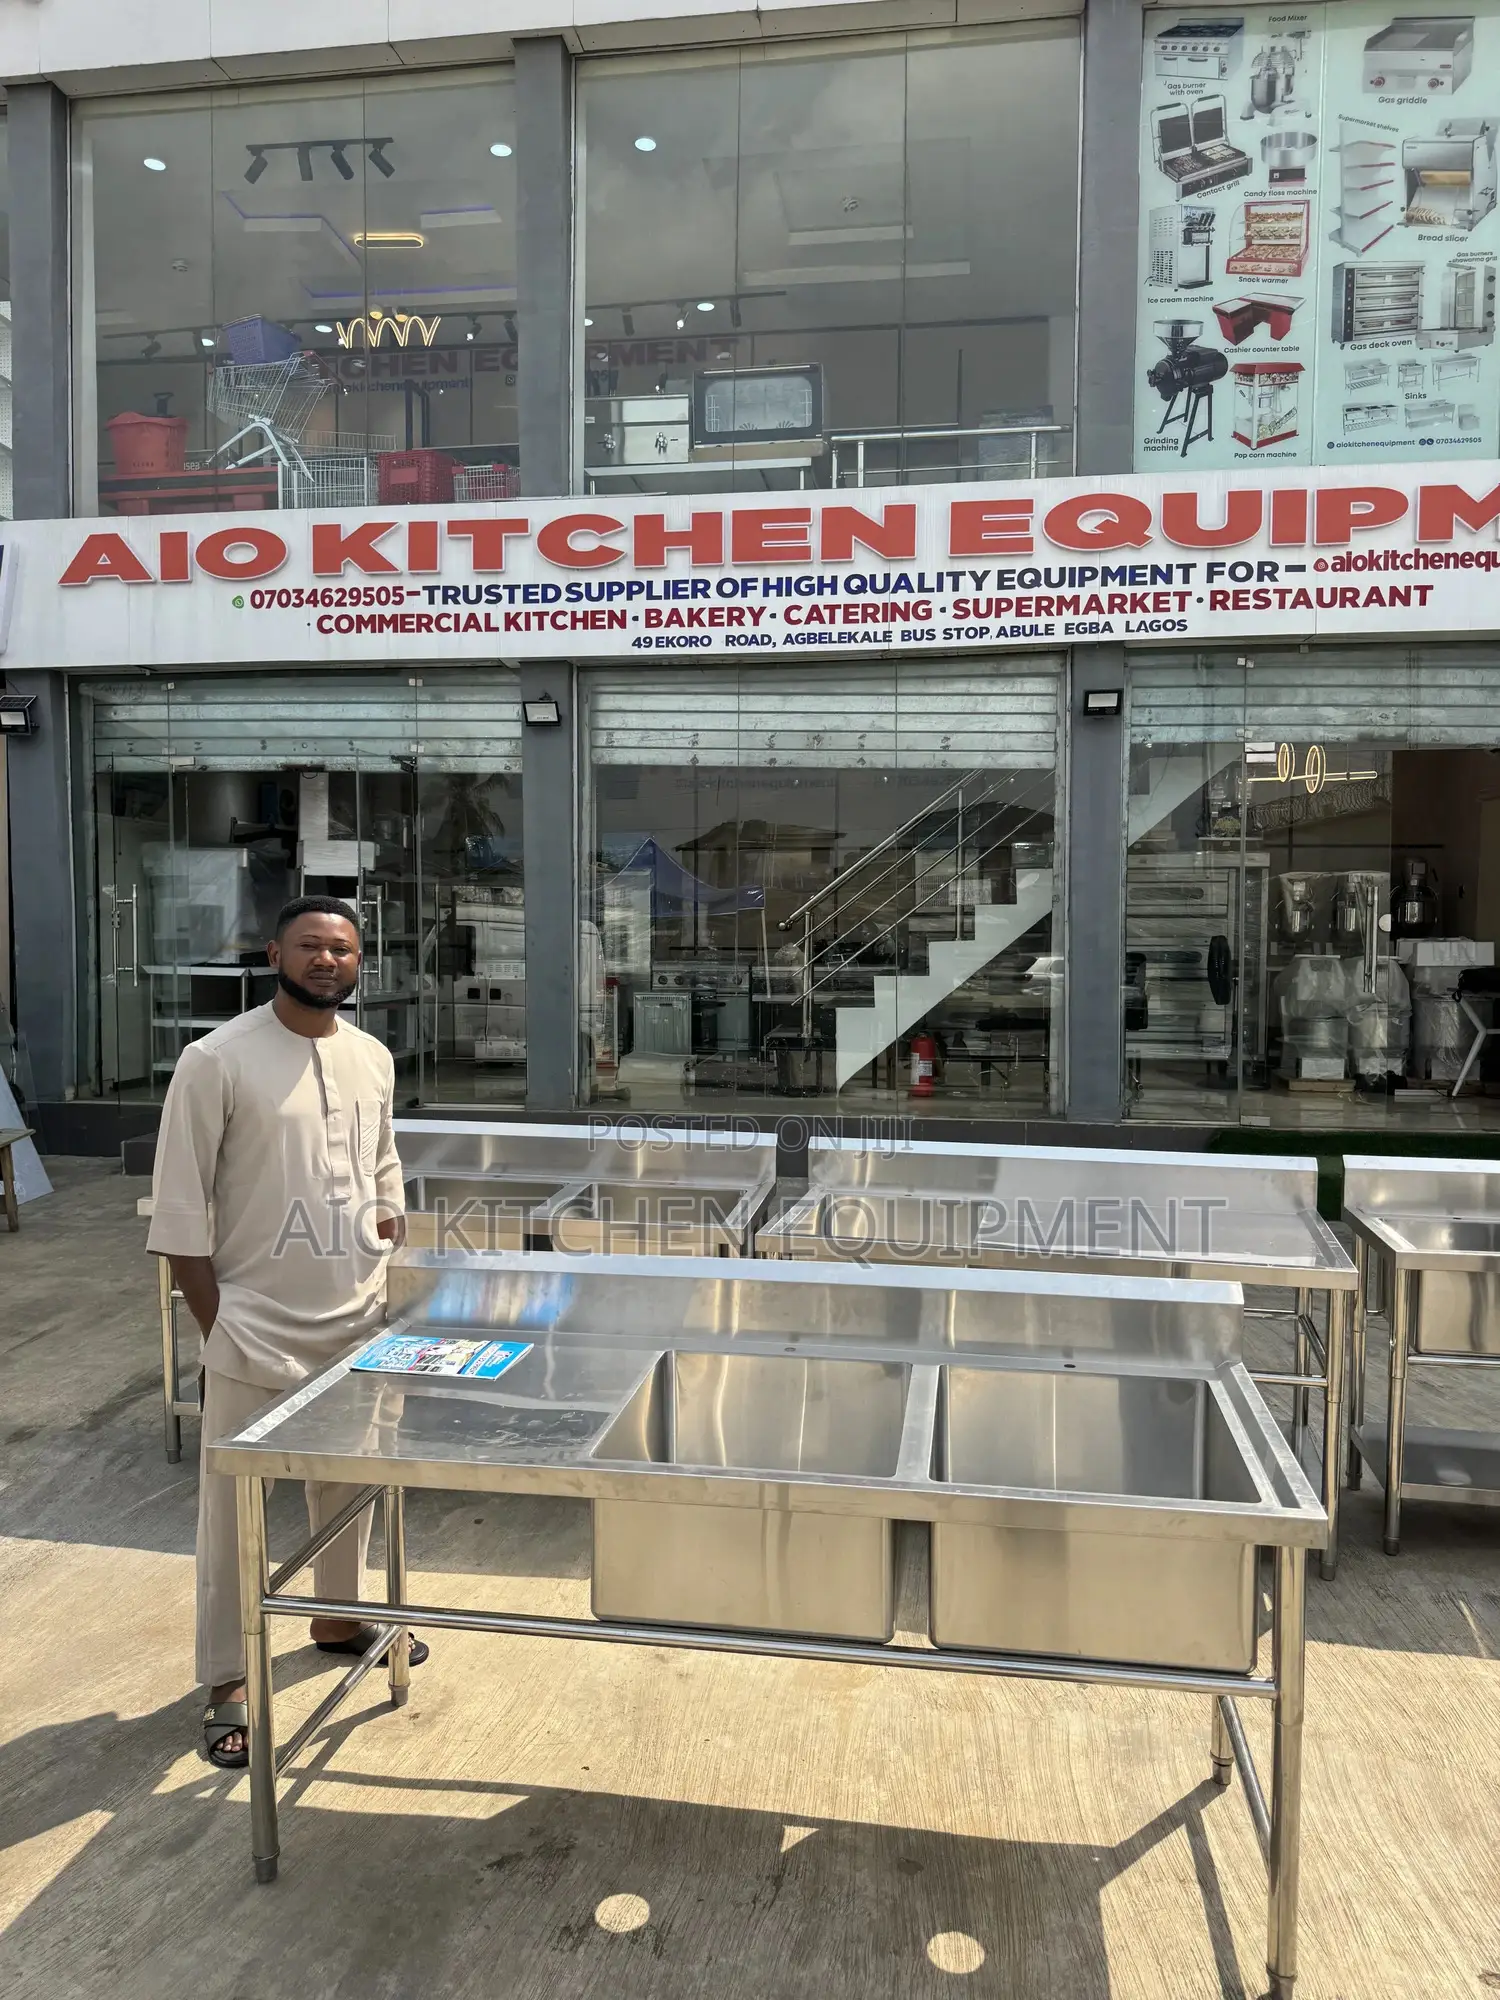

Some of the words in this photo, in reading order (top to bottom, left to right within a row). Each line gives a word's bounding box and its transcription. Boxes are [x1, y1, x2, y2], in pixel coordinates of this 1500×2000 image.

[1268, 14, 1285, 23] Food
[1286, 13, 1308, 22] Mixer
[1378, 96, 1395, 104] Gas
[1396, 96, 1428, 107] griddle
[1196, 183, 1223, 199] Contact
[1223, 179, 1241, 192] grill
[1243, 190, 1266, 200] Candy
[1266, 189, 1284, 197] floss
[1285, 188, 1318, 197] machine
[1417, 234, 1443, 242] Bread
[1444, 234, 1469, 242] slicer
[1238, 276, 1260, 284] Snack
[1261, 277, 1289, 285] warmer
[1183, 296, 1214, 304] machine
[1223, 346, 1250, 355] Cashier
[1252, 345, 1280, 354] counter
[1281, 344, 1300, 353] table
[1350, 342, 1367, 351] Gas
[1369, 340, 1390, 349] deck
[1391, 340, 1412, 348] oven
[1404, 392, 1428, 400] Sinks
[1143, 437, 1179, 446] Grinding
[1143, 444, 1179, 452] machine
[1234, 452, 1247, 460] Pop
[1266, 450, 1297, 459] machine
[58, 526, 288, 586] AIO
[311, 504, 918, 577] KITCHEN
[949, 482, 1500, 556] EQUIPM
[422, 582, 562, 606] TRUSTED
[564, 579, 712, 602] SUPPLIER
[715, 577, 759, 598] OF
[762, 575, 838, 597] HIGH
[842, 569, 991, 595] QUALITY
[996, 562, 1197, 591] EQUIPMENT
[315, 610, 500, 634] COMMERCIAL
[503, 609, 627, 632] KITCHEN
[644, 606, 768, 628] BAKERY
[783, 599, 932, 625] CATERING
[952, 590, 1192, 620] SUPERMARKET
[1209, 584, 1434, 611] RESTAURANT
[632, 636, 653, 649] 49
[655, 635, 712, 648] EKORO
[725, 633, 777, 648] ROAD,
[783, 630, 892, 646] AGBELEKALE
[900, 628, 936, 642] BUS
[995, 623, 1055, 638] ABULE
[1064, 620, 1114, 635] EGBA
[1124, 618, 1188, 633] LAGOS
